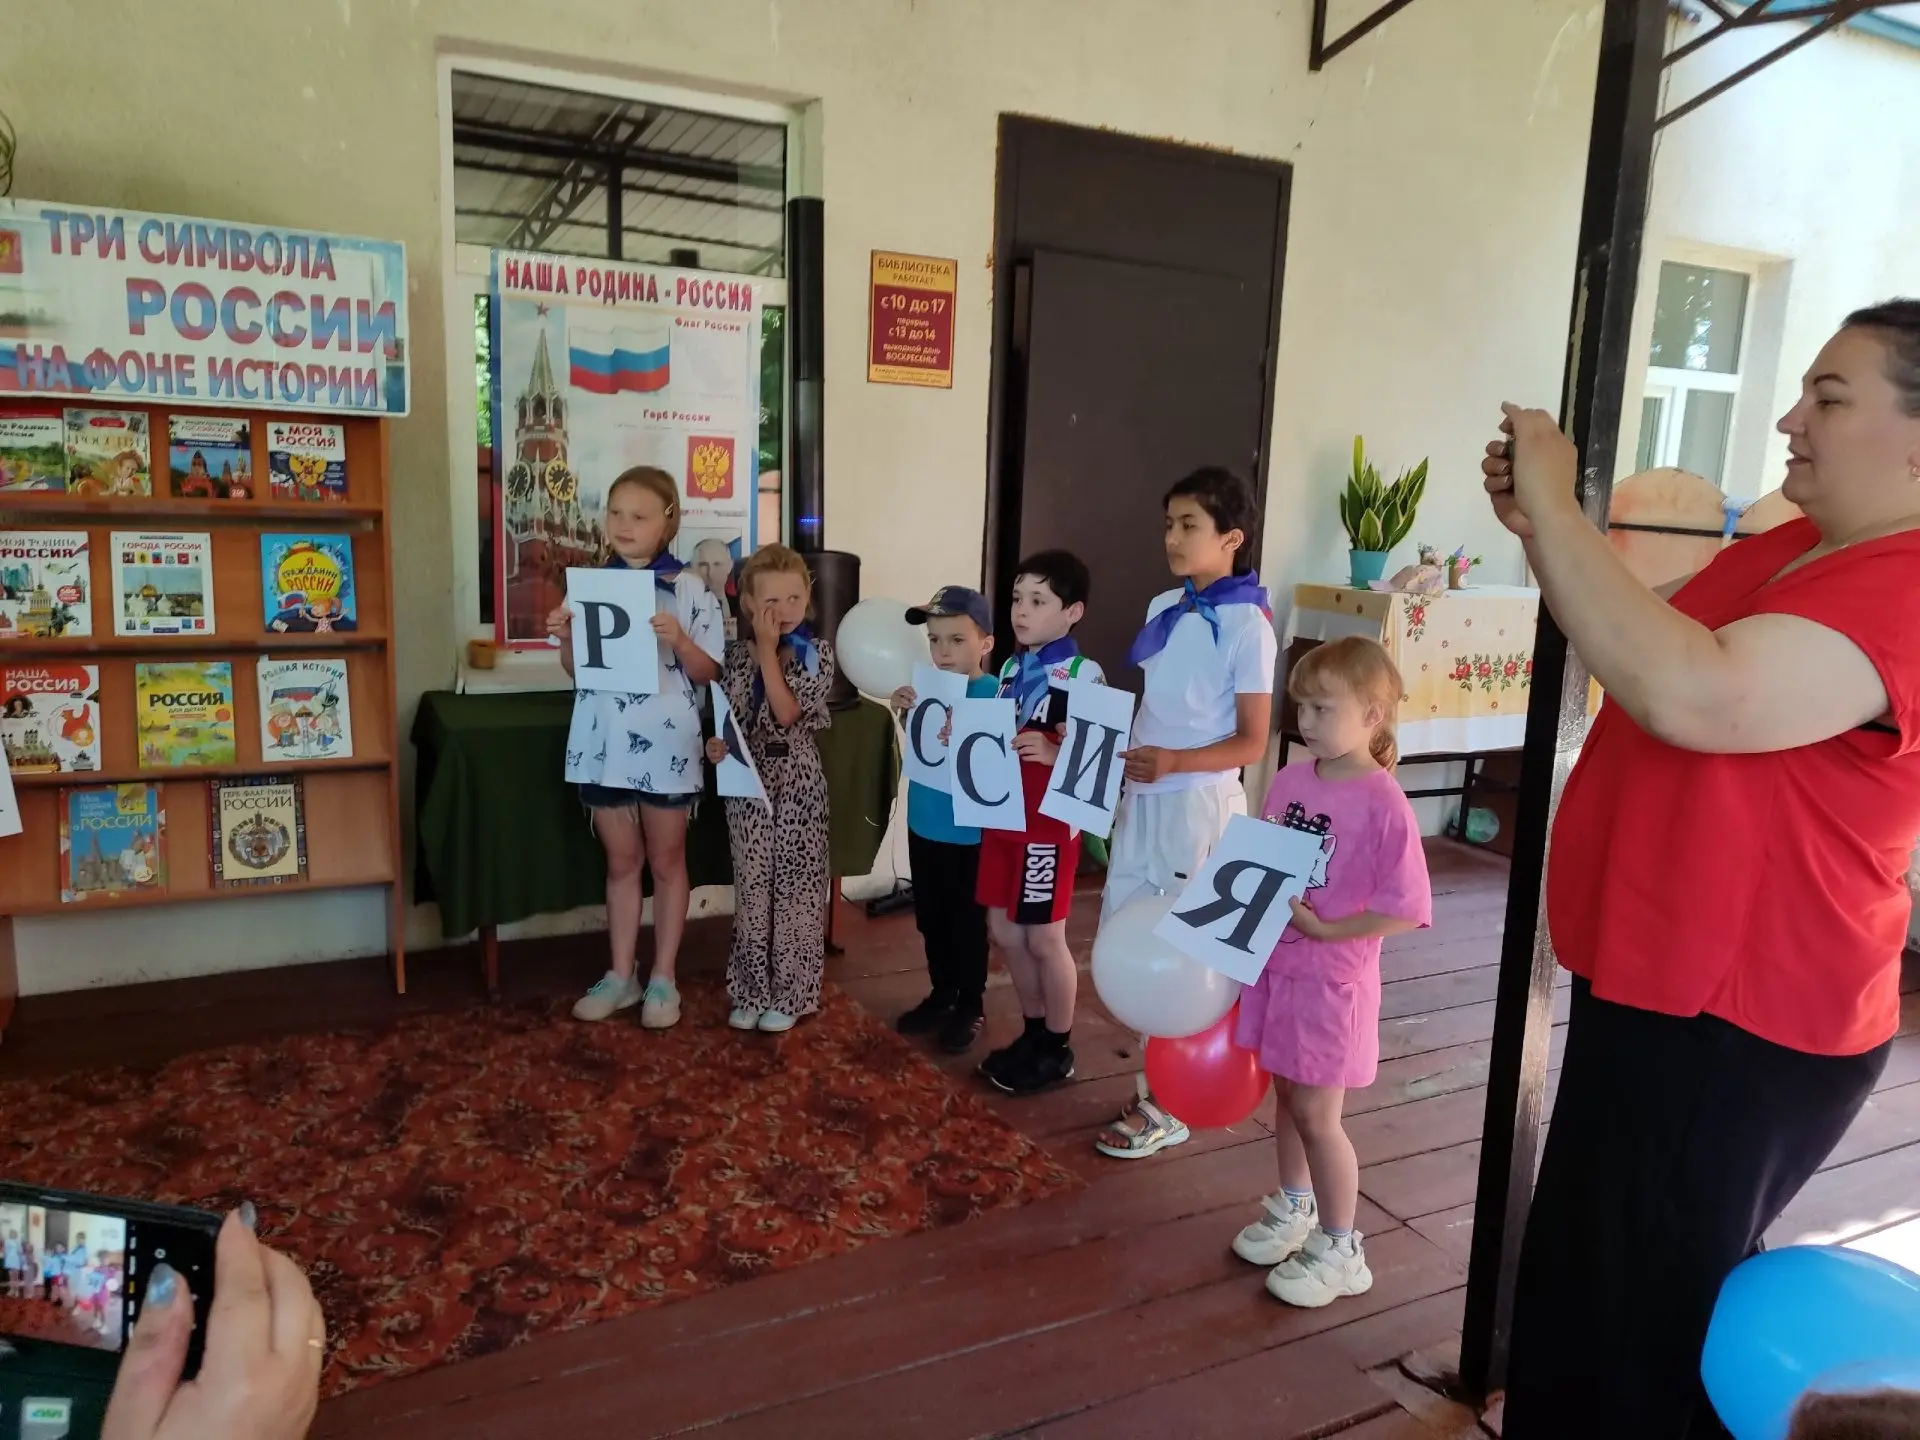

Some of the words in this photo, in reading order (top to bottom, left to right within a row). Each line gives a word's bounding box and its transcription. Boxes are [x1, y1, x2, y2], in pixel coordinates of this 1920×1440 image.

[40, 209, 127, 261] ТРИ
[137, 218, 337, 282] СИМВОЛА
[878, 257, 951, 276] БИБЛИОТЕКА
[505, 257, 570, 295] НАША
[575, 266, 660, 306] РОДИНА
[676, 277, 752, 313] РОССИЯ
[890, 293, 907, 310] 10
[908, 299, 930, 314] до
[931, 298, 946, 315] 17
[125, 277, 398, 360] РОССИИ
[675, 316, 701, 328] Флаг
[704, 319, 741, 332] России
[895, 325, 907, 338] 13
[908, 329, 924, 341] до
[924, 328, 936, 341] 14
[15, 343, 73, 392] НА
[82, 346, 198, 397] ФОНЕ
[207, 356, 380, 408] ИСТОРИИ
[643, 409, 669, 421] Герб
[672, 410, 711, 422] России
[288, 425, 322, 437] МОЯ
[276, 435, 336, 448] РОССИЯ
[28, 538, 77, 547] РОДИНА
[122, 541, 161, 551] ГОРОДА
[164, 542, 202, 550] РОССИИ
[0, 547, 74, 559] РОССИЯ
[286, 575, 335, 593] РОССИИ
[574, 600, 631, 670] Р
[6, 668, 50, 679] НАША
[261, 662, 298, 680] РОДНАЯ
[302, 662, 344, 680] ИСТОРИЯ
[6, 678, 79, 692] РОССИЯ
[149, 691, 225, 708] РОССИЯ
[956, 731, 1010, 807] С
[1051, 715, 1126, 812] И
[224, 796, 293, 811] РОССИИ
[80, 813, 153, 831] РОССИИ
[1022, 842, 1057, 904] USSIA
[1170, 859, 1297, 955] Я
